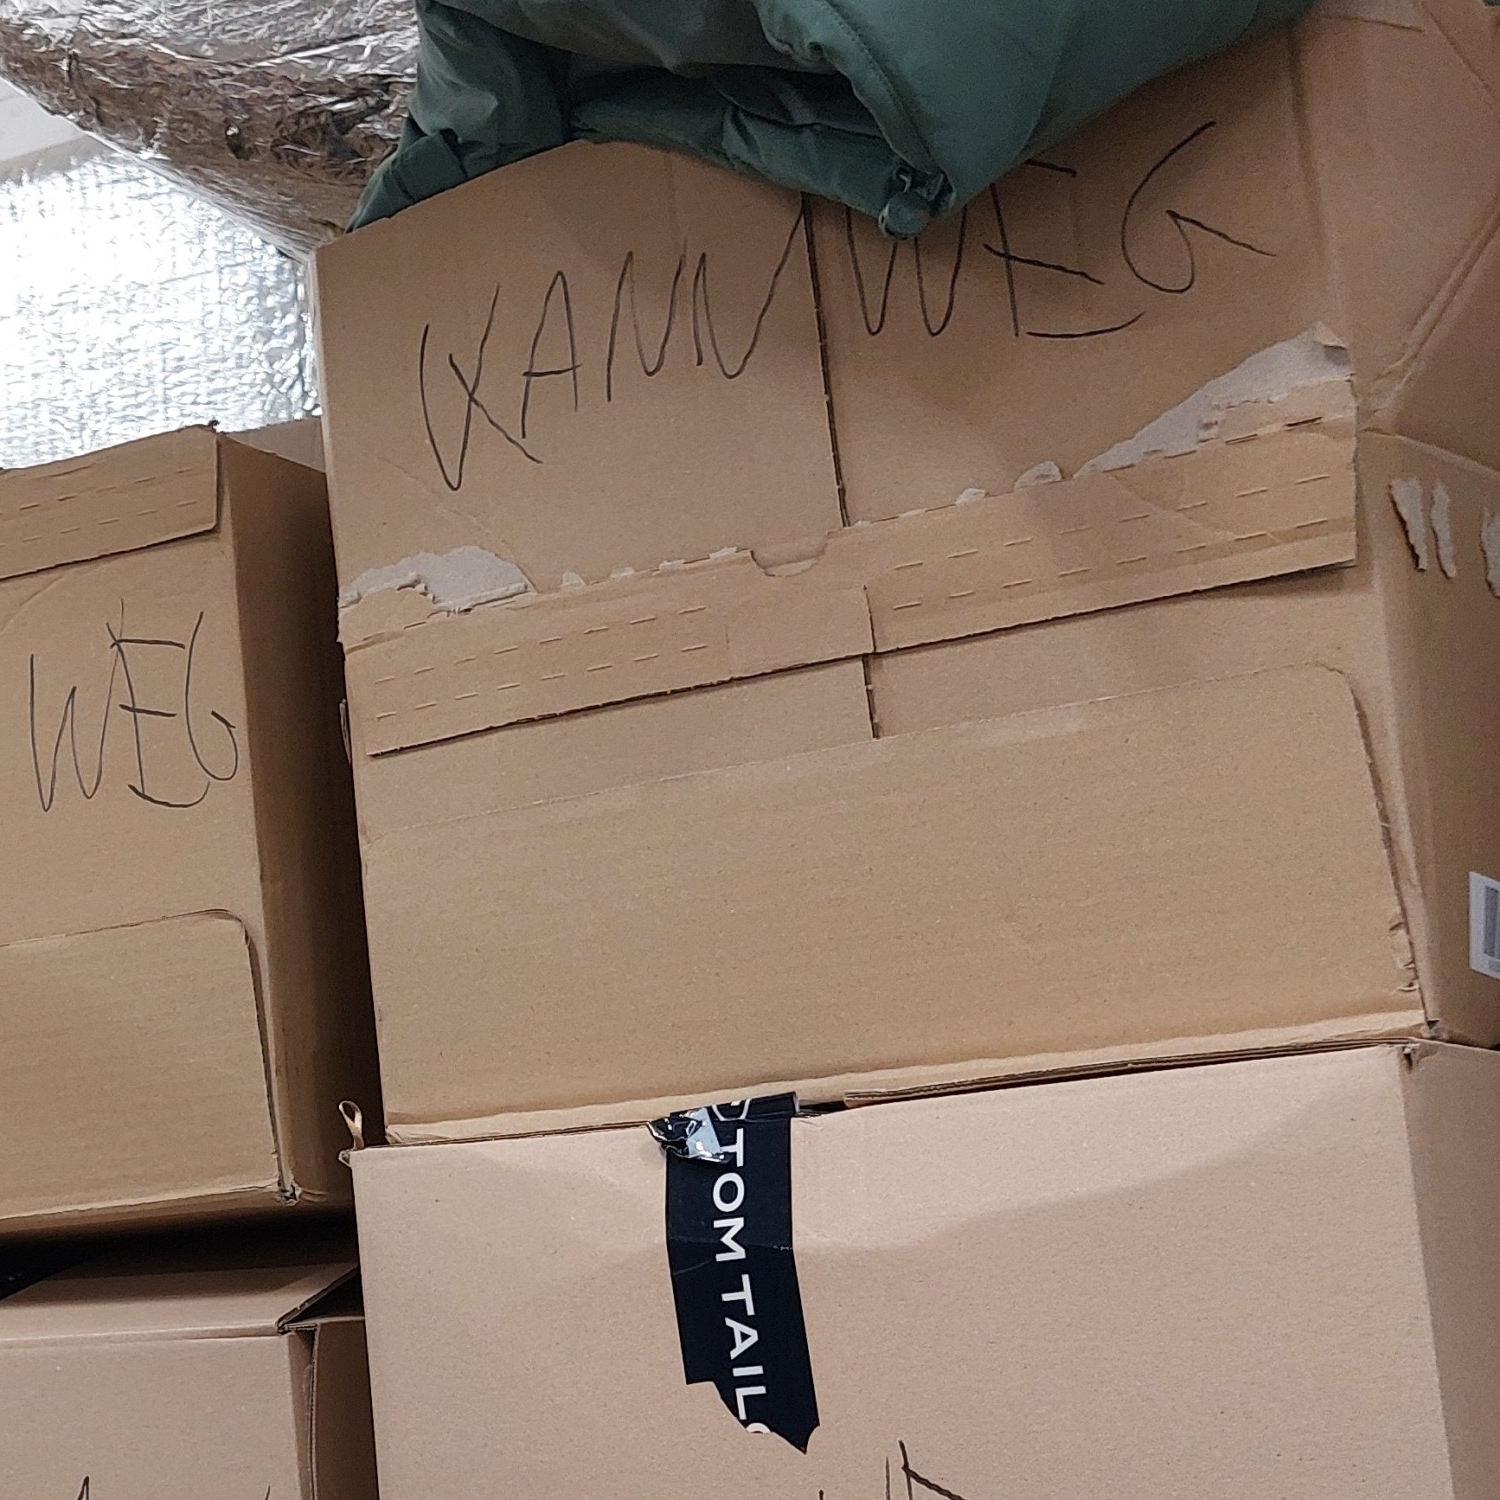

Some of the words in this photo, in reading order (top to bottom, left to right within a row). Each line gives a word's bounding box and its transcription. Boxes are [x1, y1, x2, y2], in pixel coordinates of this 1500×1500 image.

[29, 599, 238, 811] WEG
[712, 1128, 747, 1262] TOM
[721, 1274, 771, 1433] TAIL
